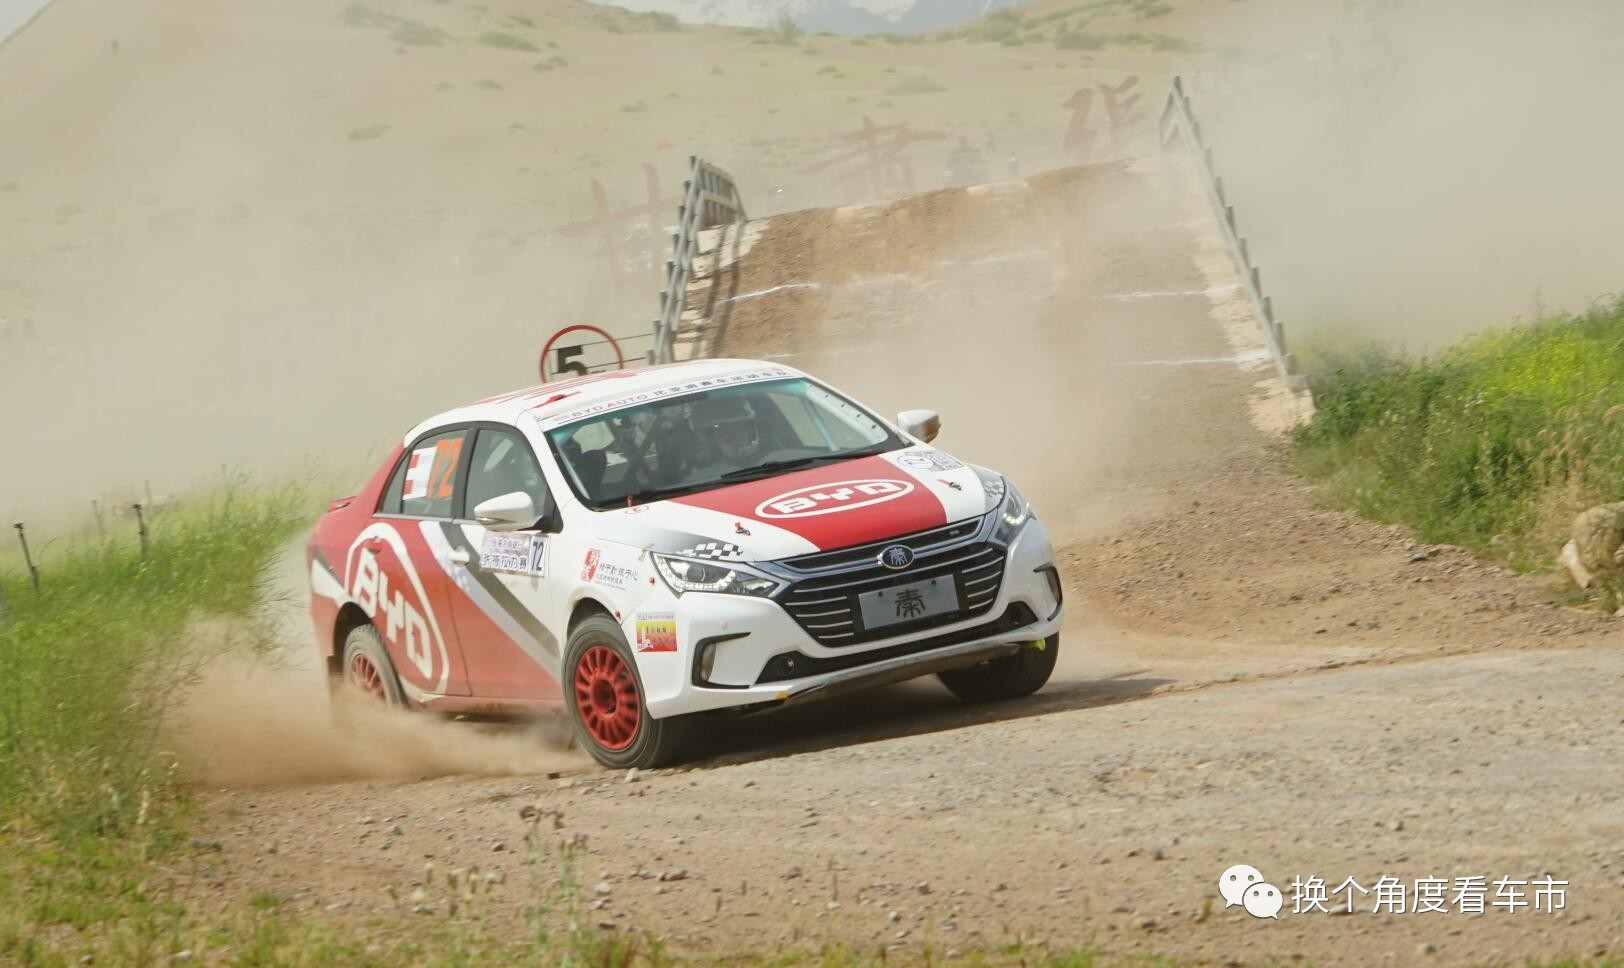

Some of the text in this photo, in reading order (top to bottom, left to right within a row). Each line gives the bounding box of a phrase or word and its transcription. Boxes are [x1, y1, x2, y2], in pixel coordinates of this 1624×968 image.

[572, 394, 648, 417] BYD AUTO
[426, 437, 462, 499] 72
[769, 482, 902, 513] BYD
[532, 541, 544, 571] 72
[351, 547, 432, 681] BYD
[894, 588, 926, 618] 秦
